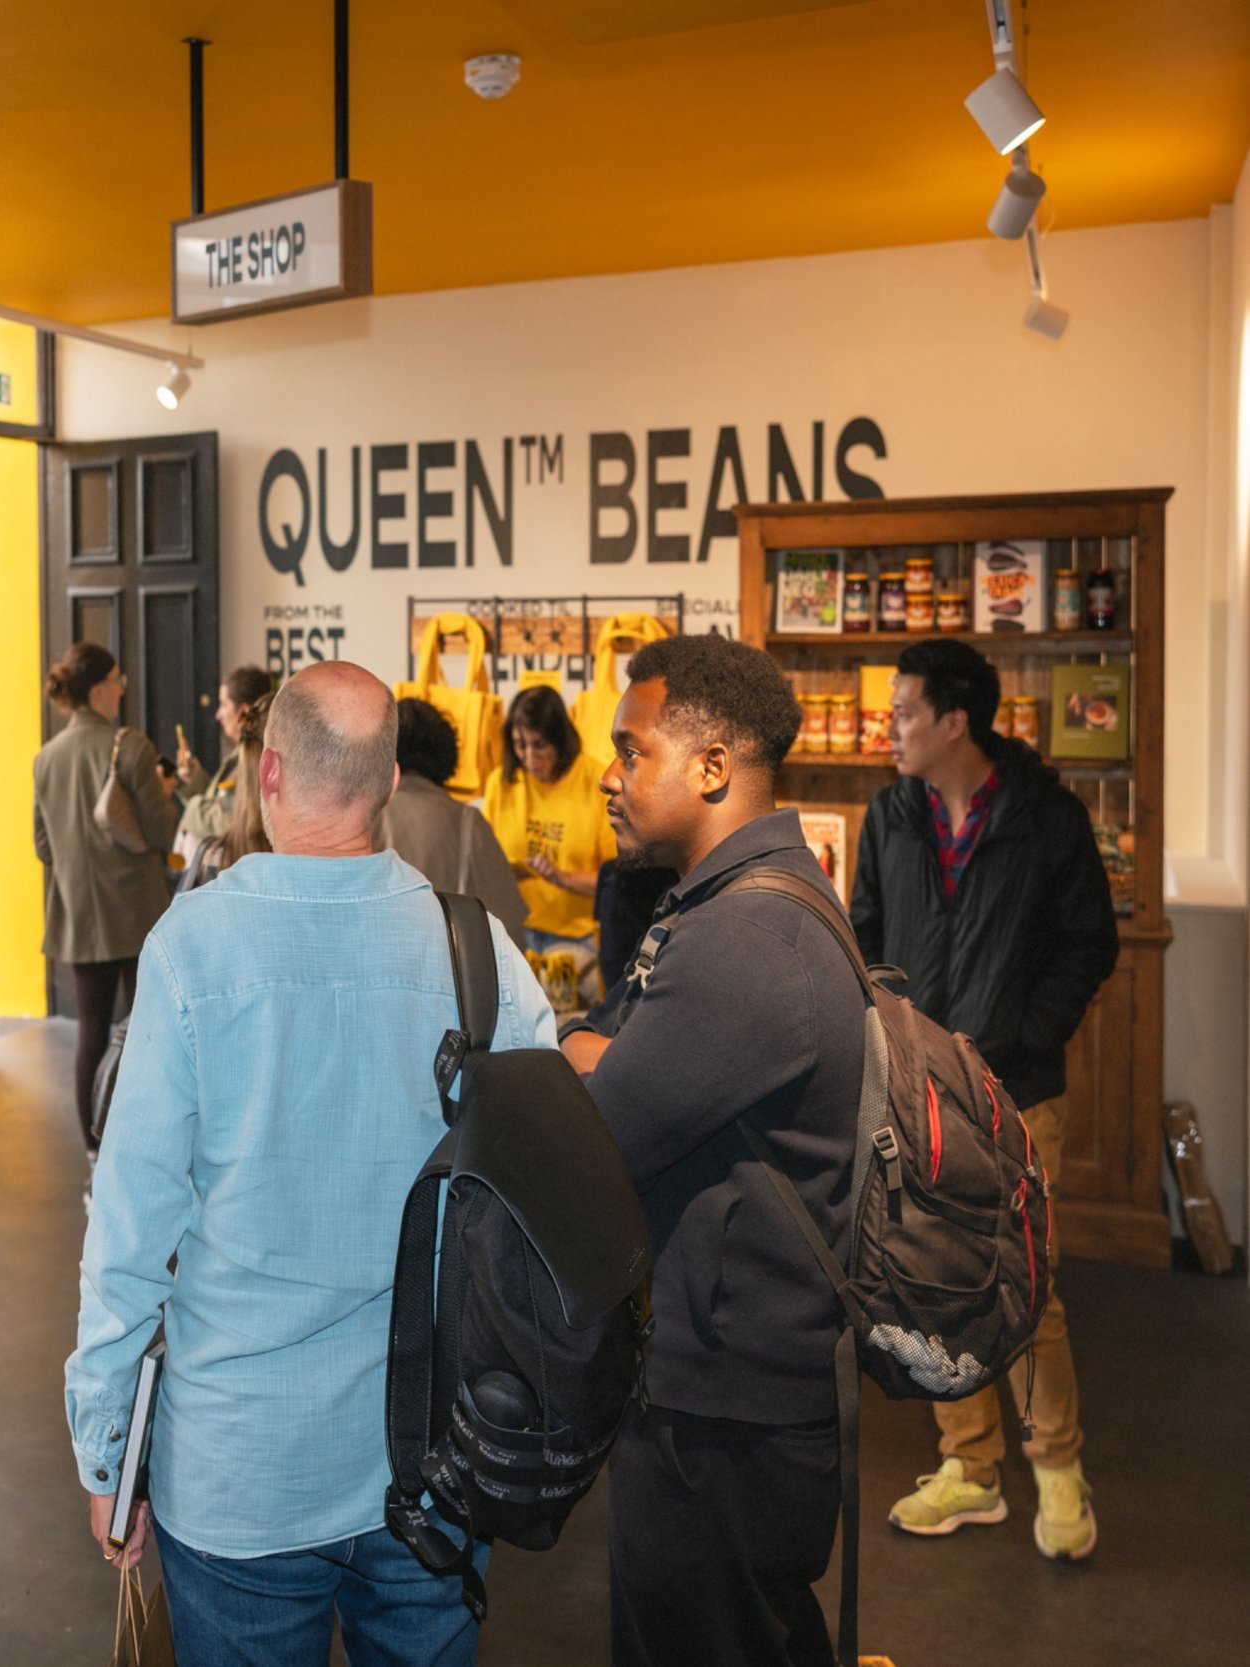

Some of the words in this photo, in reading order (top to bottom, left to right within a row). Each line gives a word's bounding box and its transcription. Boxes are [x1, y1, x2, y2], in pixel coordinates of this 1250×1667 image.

[205, 235, 243, 289] THE
[248, 221, 306, 280] SHOP
[264, 604, 309, 620] FROM
[313, 604, 343, 620] THE
[266, 627, 345, 680] BEST
